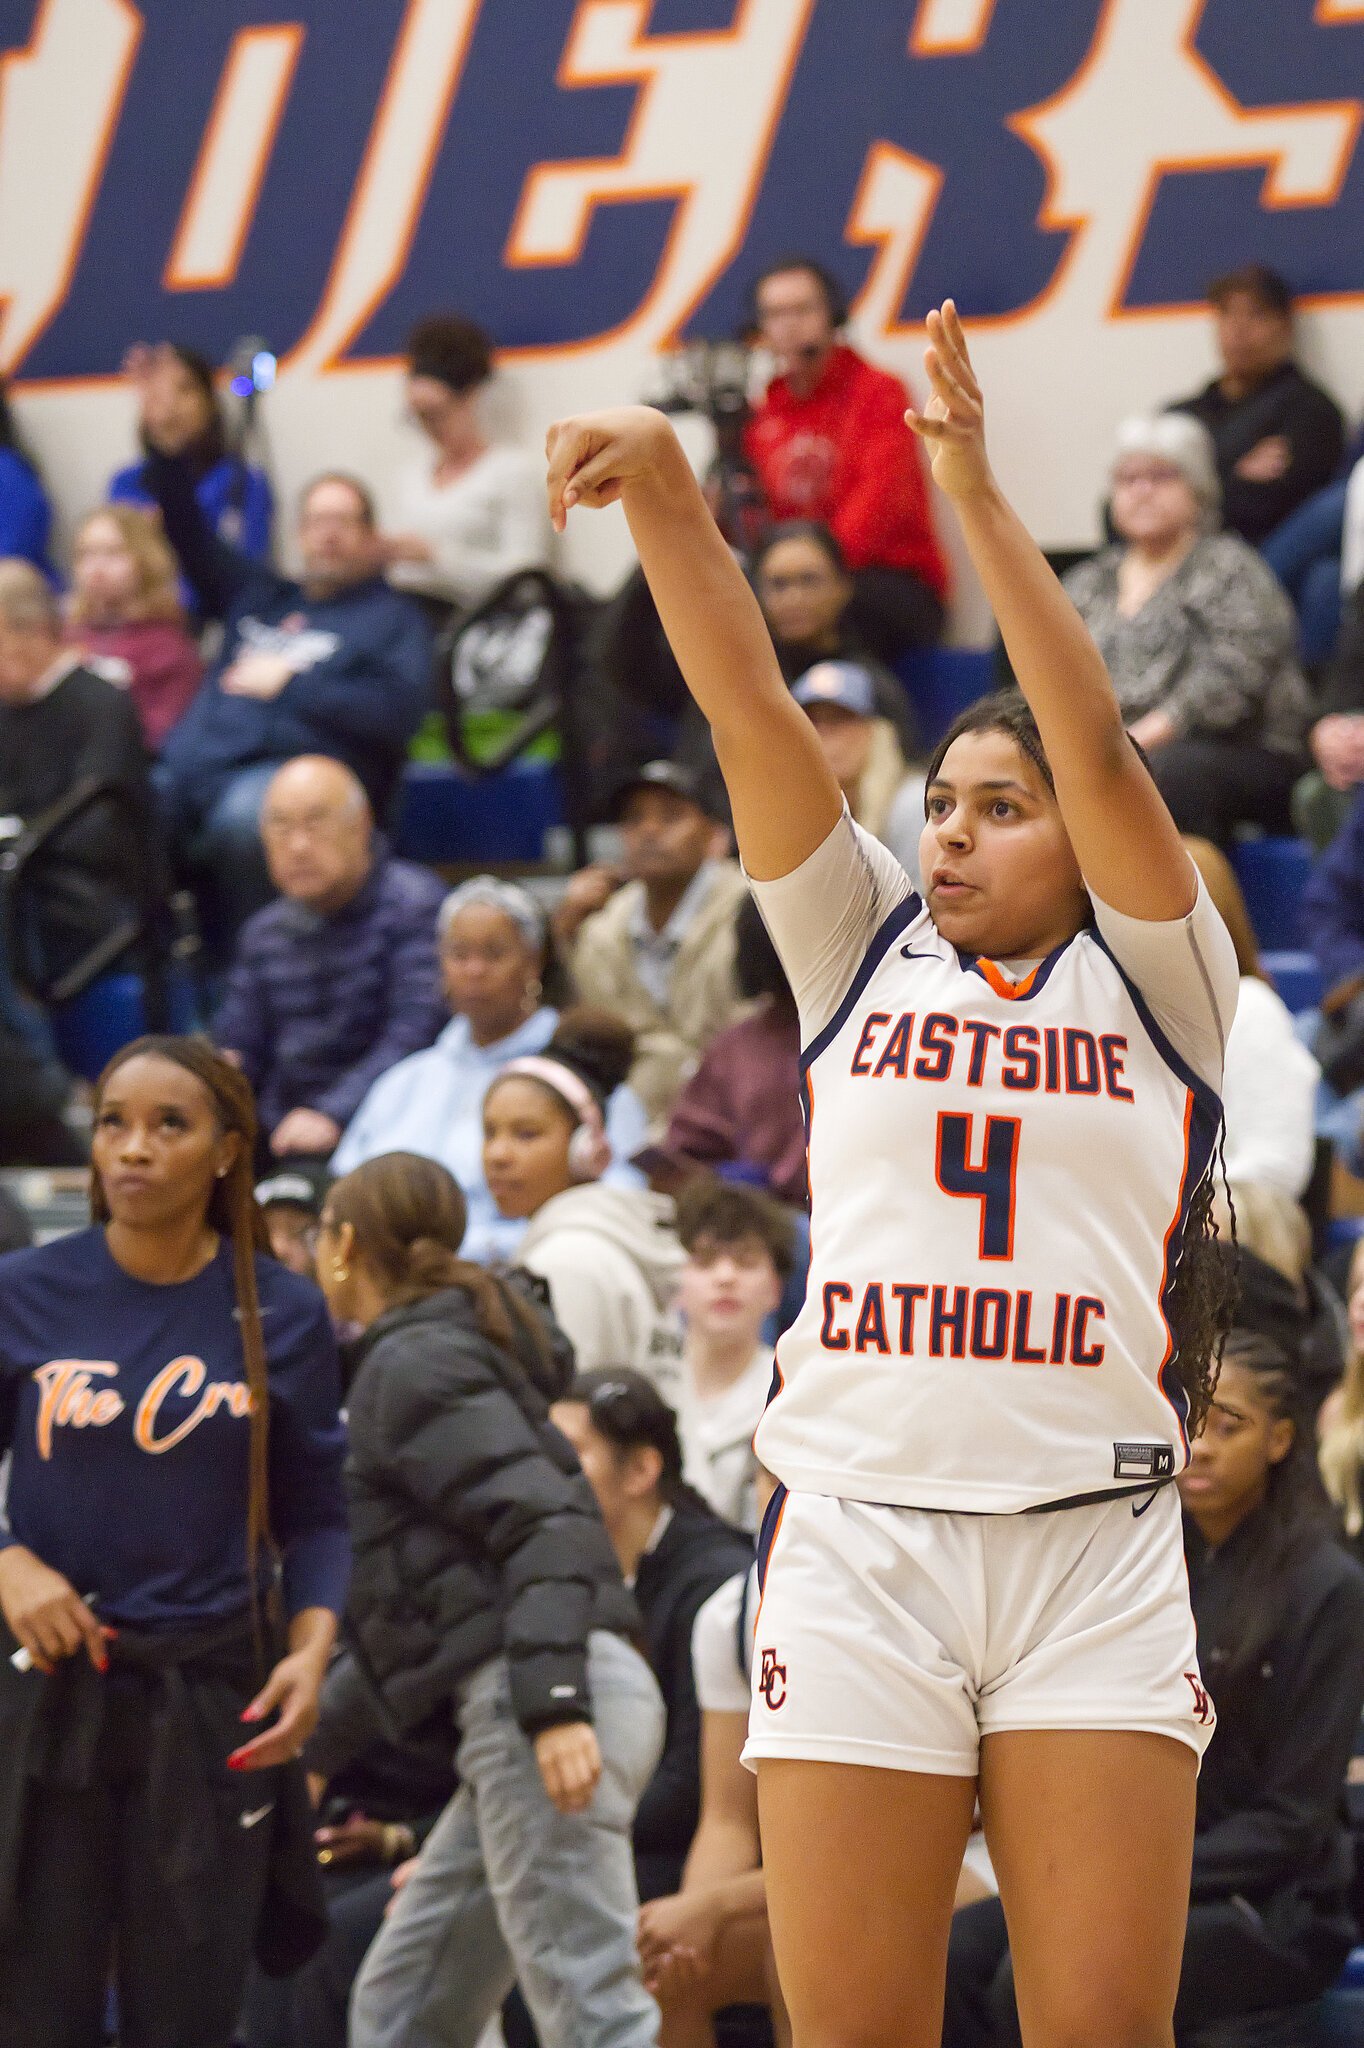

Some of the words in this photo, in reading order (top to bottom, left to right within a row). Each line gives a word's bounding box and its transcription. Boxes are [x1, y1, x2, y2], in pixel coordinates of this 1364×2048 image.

[0, 0, 1364, 390] DERS
[850, 1012, 1135, 1104] EASTSIDE
[935, 1111, 1022, 1262] 4
[820, 1281, 1105, 1367] CATHOLIC
[32, 1358, 126, 1462] The
[1158, 1455, 1169, 1470] M
[759, 1648, 786, 1710] EC
